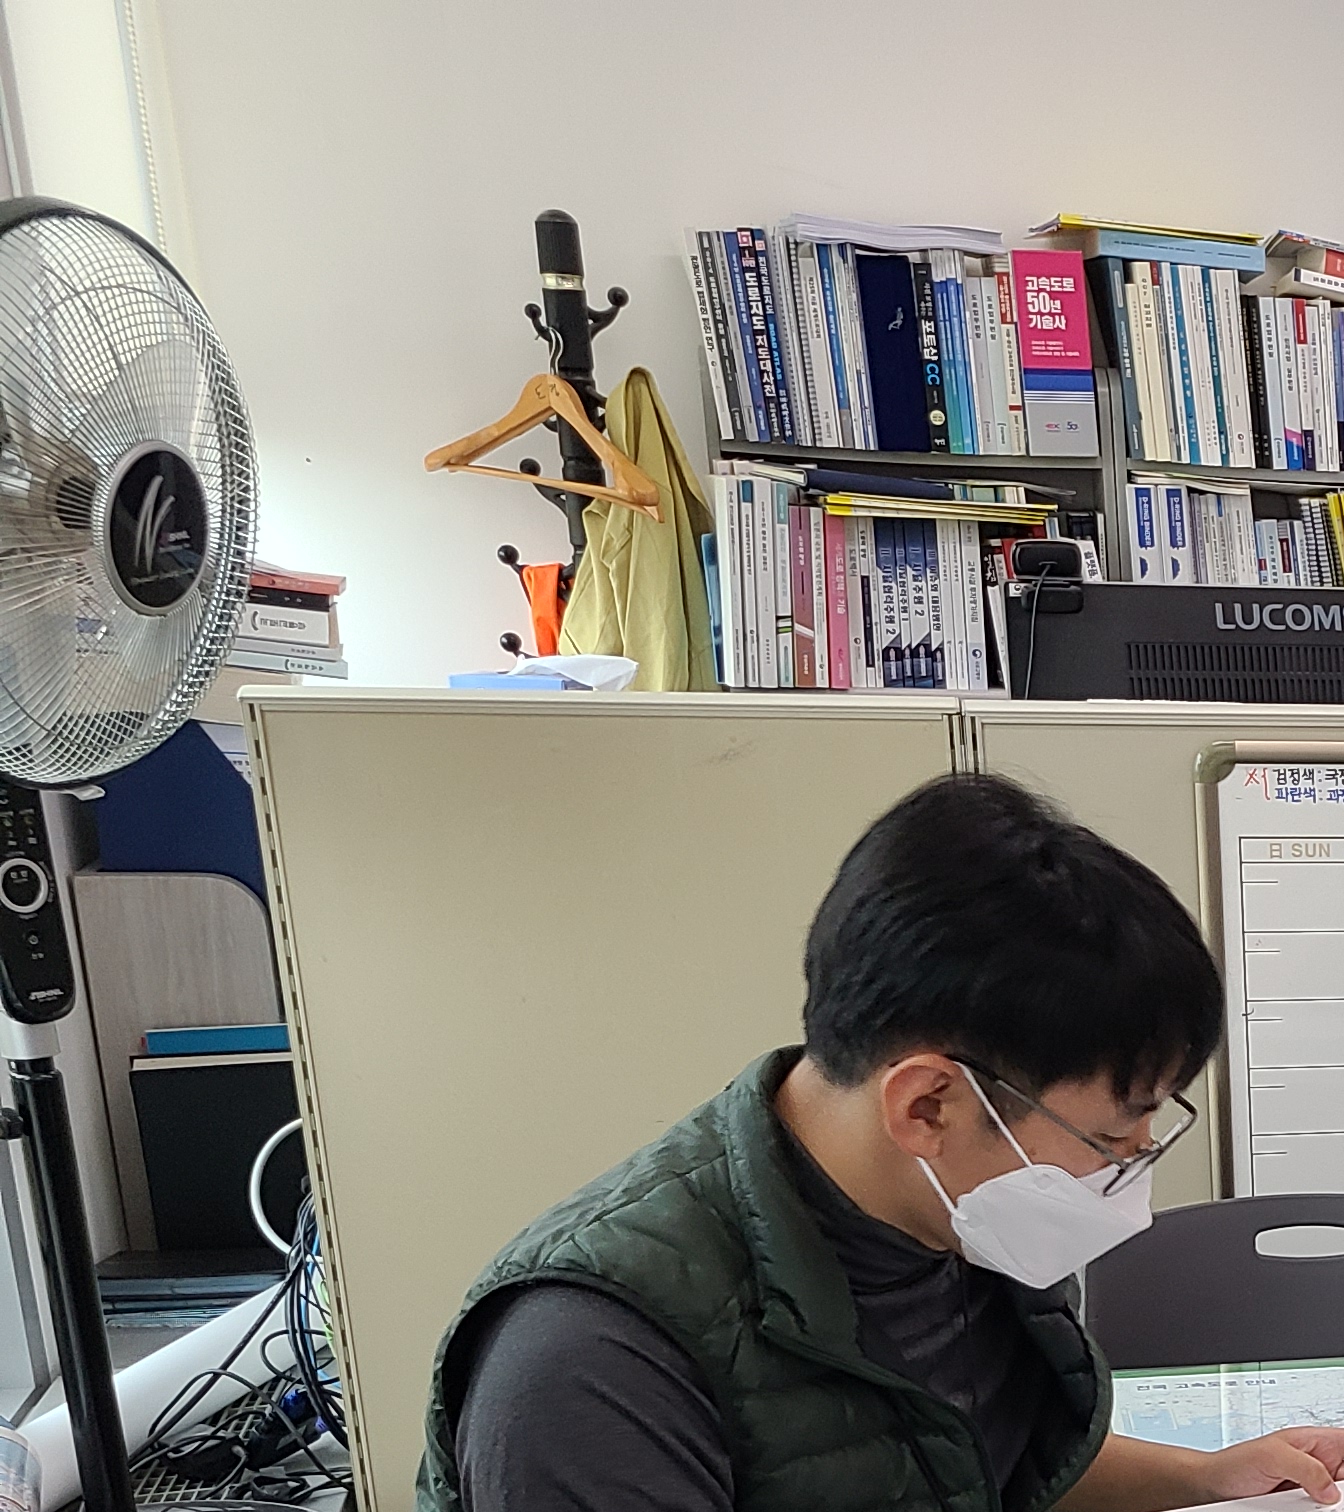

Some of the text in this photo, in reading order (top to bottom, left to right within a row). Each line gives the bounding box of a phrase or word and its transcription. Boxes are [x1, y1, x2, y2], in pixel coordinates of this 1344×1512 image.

[1025, 276, 1075, 291] 고속도로
[1026, 292, 1062, 313] 50년
[1028, 315, 1067, 330] 기술사
[925, 363, 940, 385] CC
[1269, 843, 1331, 858] 日 SUN
